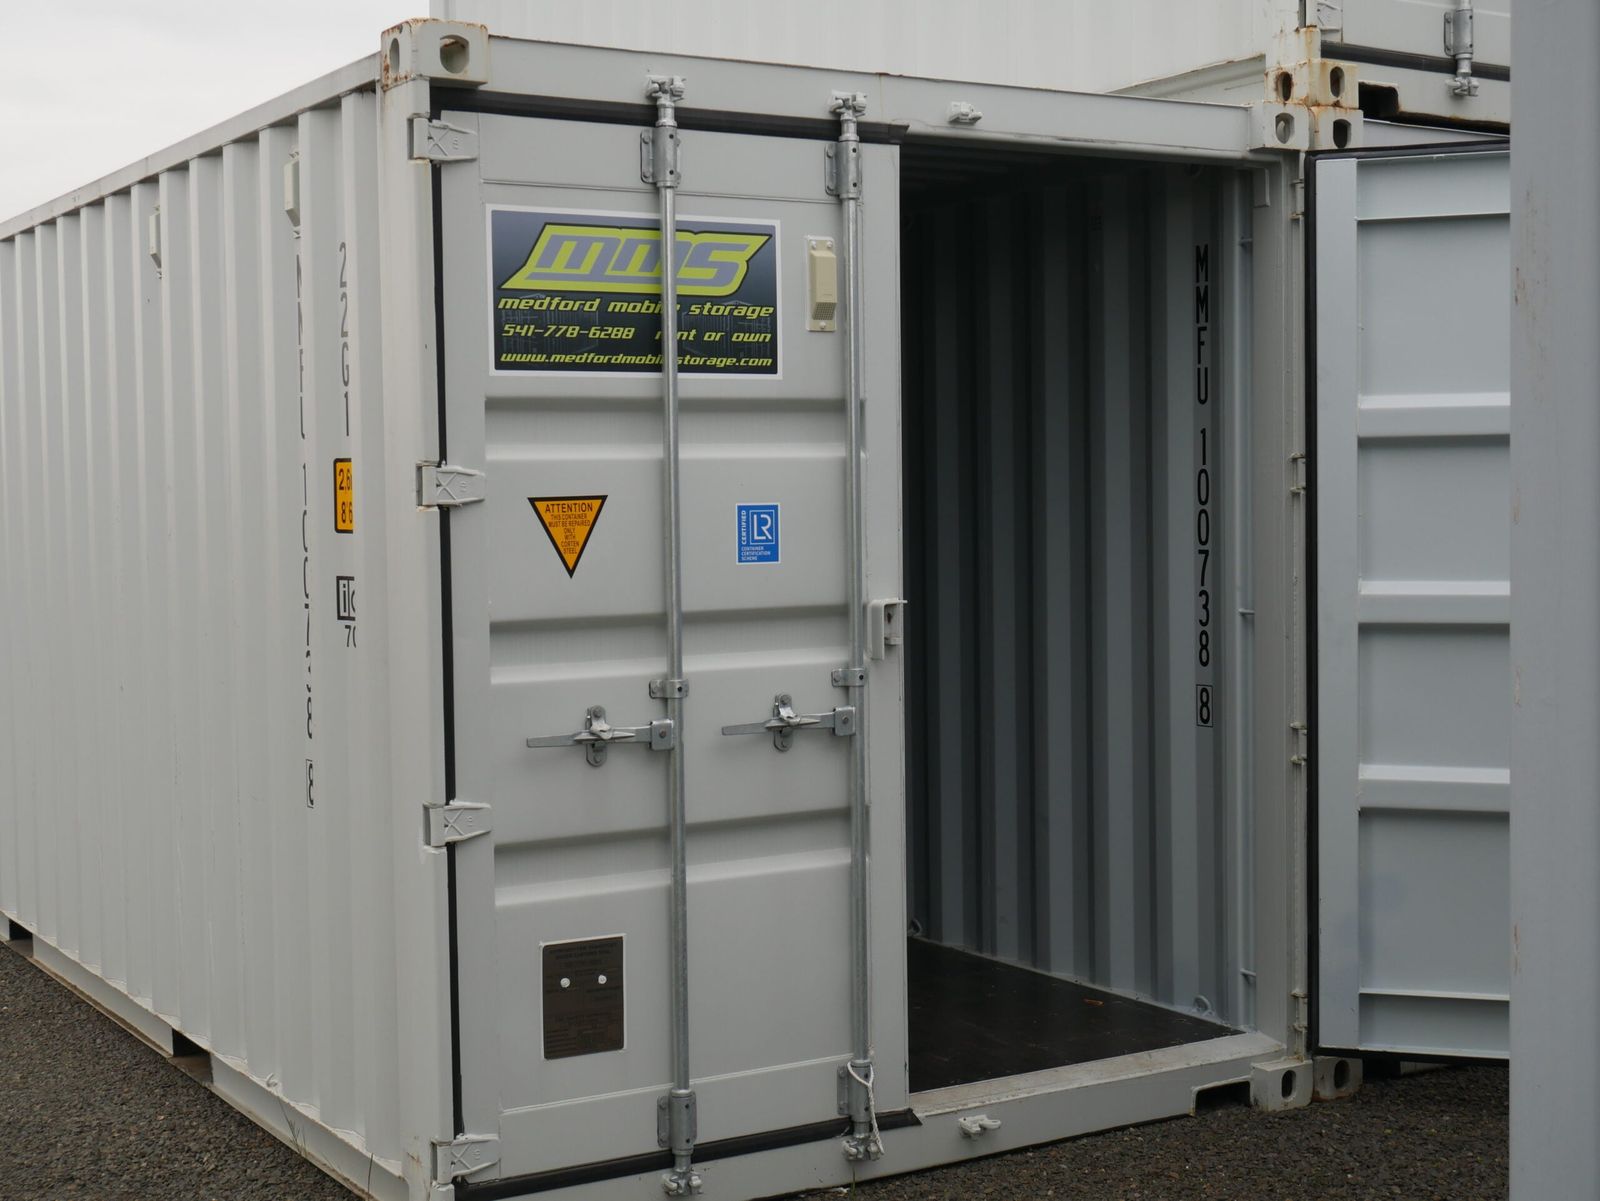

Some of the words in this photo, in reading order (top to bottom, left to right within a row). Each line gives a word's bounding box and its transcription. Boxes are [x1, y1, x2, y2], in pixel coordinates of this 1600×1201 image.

[498, 296, 601, 312] medford
[607, 300, 681, 314] mobi
[688, 302, 775, 319] storage
[339, 242, 350, 437] 22G1
[502, 324, 635, 339] 541-778-6288
[655, 329, 697, 341] rnt
[703, 332, 726, 341] or
[731, 332, 772, 342] own
[1195, 244, 1208, 405] MMFU
[545, 502, 593, 513] ATTENTION
[754, 514, 772, 540] LR
[1197, 428, 1210, 667] 100738
[1199, 686, 1211, 725] 8
